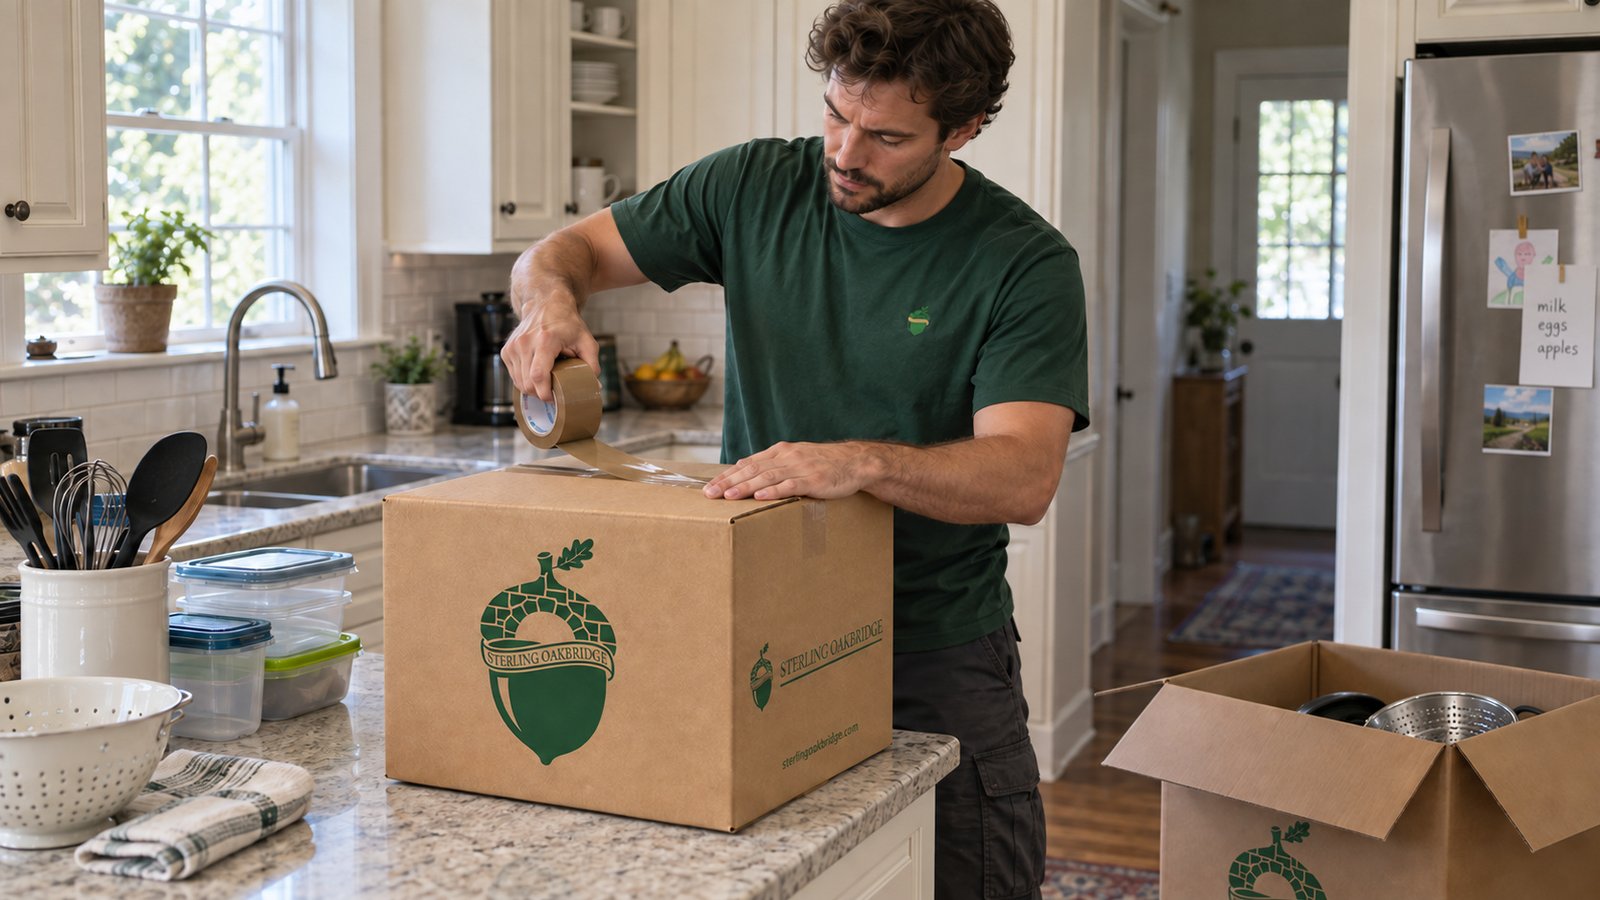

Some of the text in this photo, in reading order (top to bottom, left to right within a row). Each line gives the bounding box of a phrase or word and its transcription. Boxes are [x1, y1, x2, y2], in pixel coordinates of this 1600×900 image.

[1537, 298, 1567, 313] milk
[1538, 320, 1567, 337] eggs
[1537, 340, 1578, 360] apples
[487, 647, 608, 667] STERLING OAKBRIDGE
[780, 619, 883, 678] STERLING OAKBRIDGE
[782, 723, 859, 770] sterlingoakbridge.com
